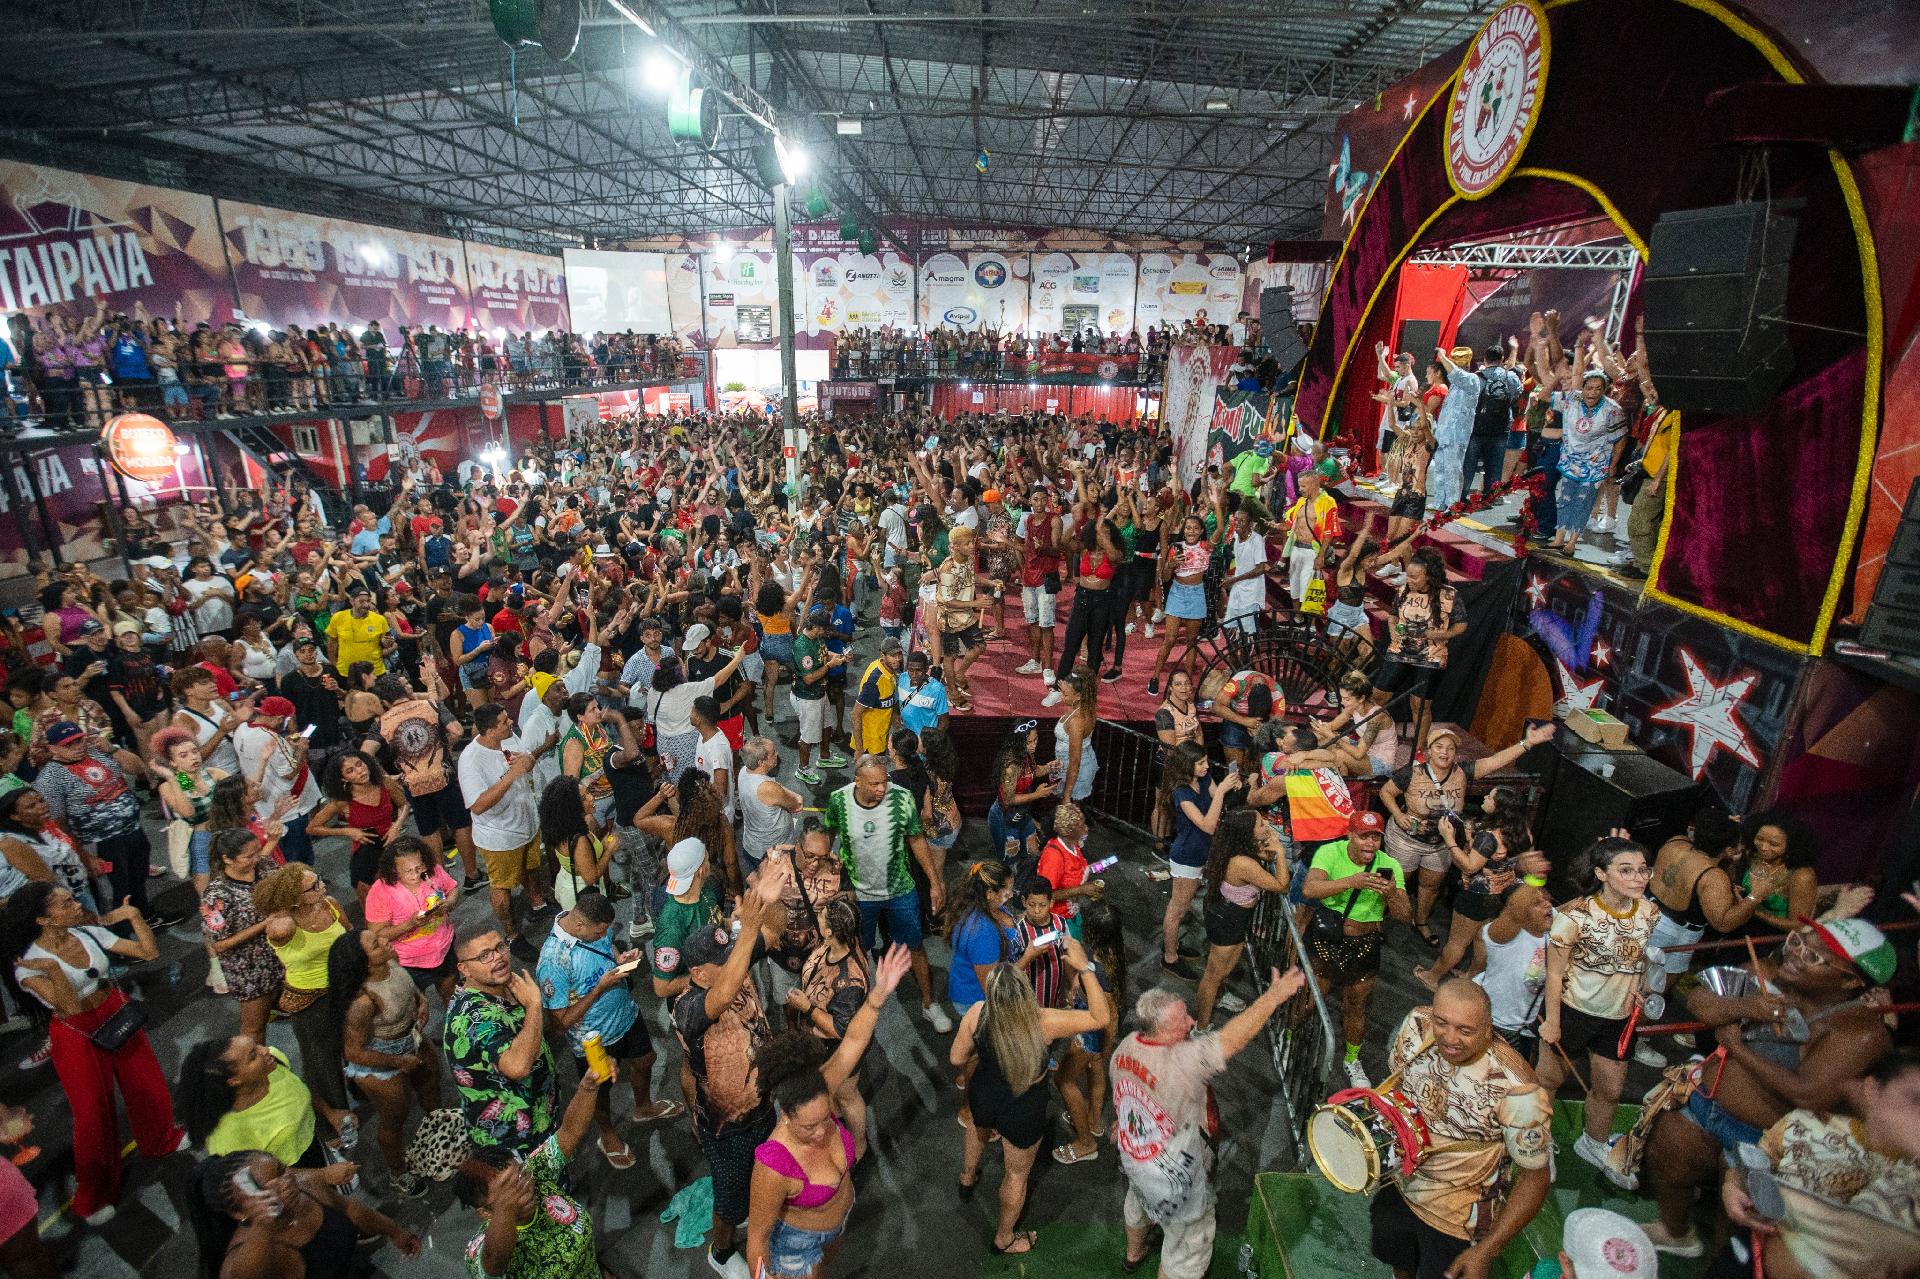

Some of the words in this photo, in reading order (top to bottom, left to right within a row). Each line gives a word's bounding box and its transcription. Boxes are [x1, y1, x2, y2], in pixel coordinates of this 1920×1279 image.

[938, 275, 965, 283] magma
[1039, 281, 1057, 289] ACG
[949, 312, 971, 321] Avipol
[822, 386, 871, 397] BOUTIQUE
